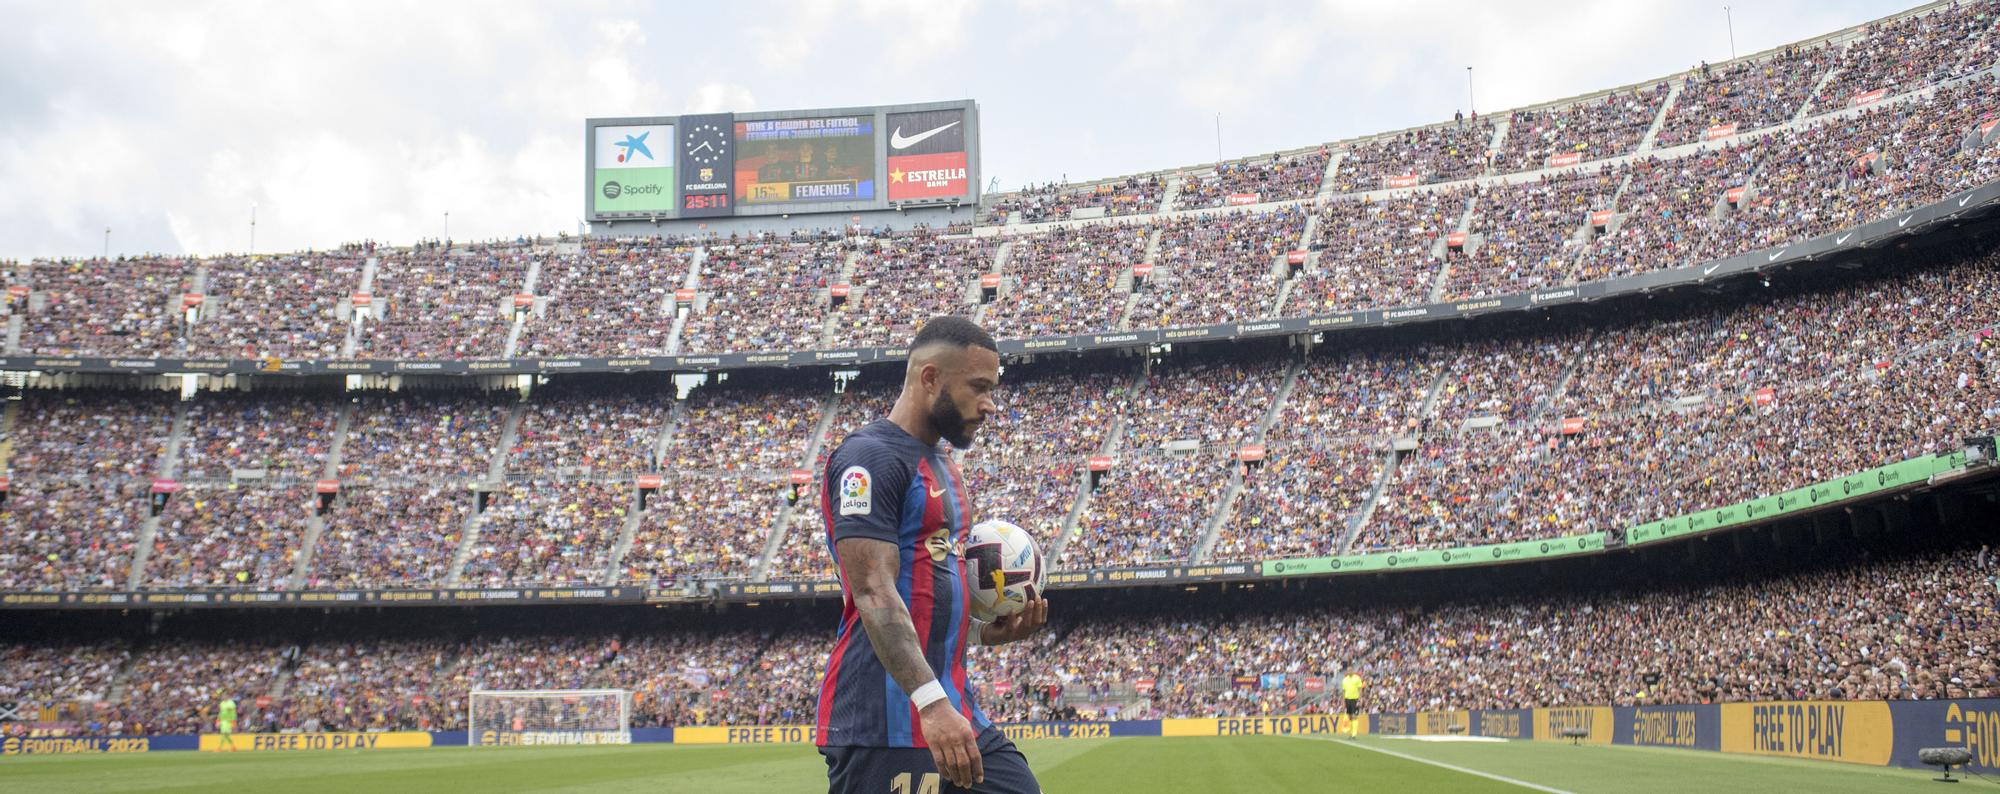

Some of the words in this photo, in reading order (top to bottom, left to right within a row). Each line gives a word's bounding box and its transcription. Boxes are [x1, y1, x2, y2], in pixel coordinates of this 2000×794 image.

[810, 120, 824, 128] DEL
[826, 118, 858, 128] FUTBOL
[908, 168, 966, 182] ESTRELLA
[624, 184, 662, 195] Spotify
[686, 194, 727, 208] 25:11
[1546, 290, 1574, 300] BARCELONA
[1397, 309, 1427, 318] BARCELONA
[1251, 323, 1280, 331] BARCELONA
[843, 500, 868, 508] LaLiga
[1218, 720, 1264, 735] FREE
[1270, 718, 1292, 734] TO
[1298, 717, 1339, 734] PLAY
[1549, 710, 1564, 738] FREE
[1565, 710, 1573, 736] TO
[1575, 709, 1593, 738] PLAY
[1676, 710, 1696, 746] 2023
[728, 728, 773, 744] FREE
[779, 728, 801, 742] TO
[1004, 724, 1062, 739] OTBALL
[1068, 724, 1110, 738] 2023
[1753, 705, 1784, 752] FREE
[1786, 705, 1803, 754] TO
[1808, 705, 1844, 758] PLAY
[107, 738, 149, 752] 2023
[255, 736, 298, 750] FREE
[305, 735, 326, 750] TO
[334, 735, 378, 750] PLAY
[891, 772, 940, 794] 14
